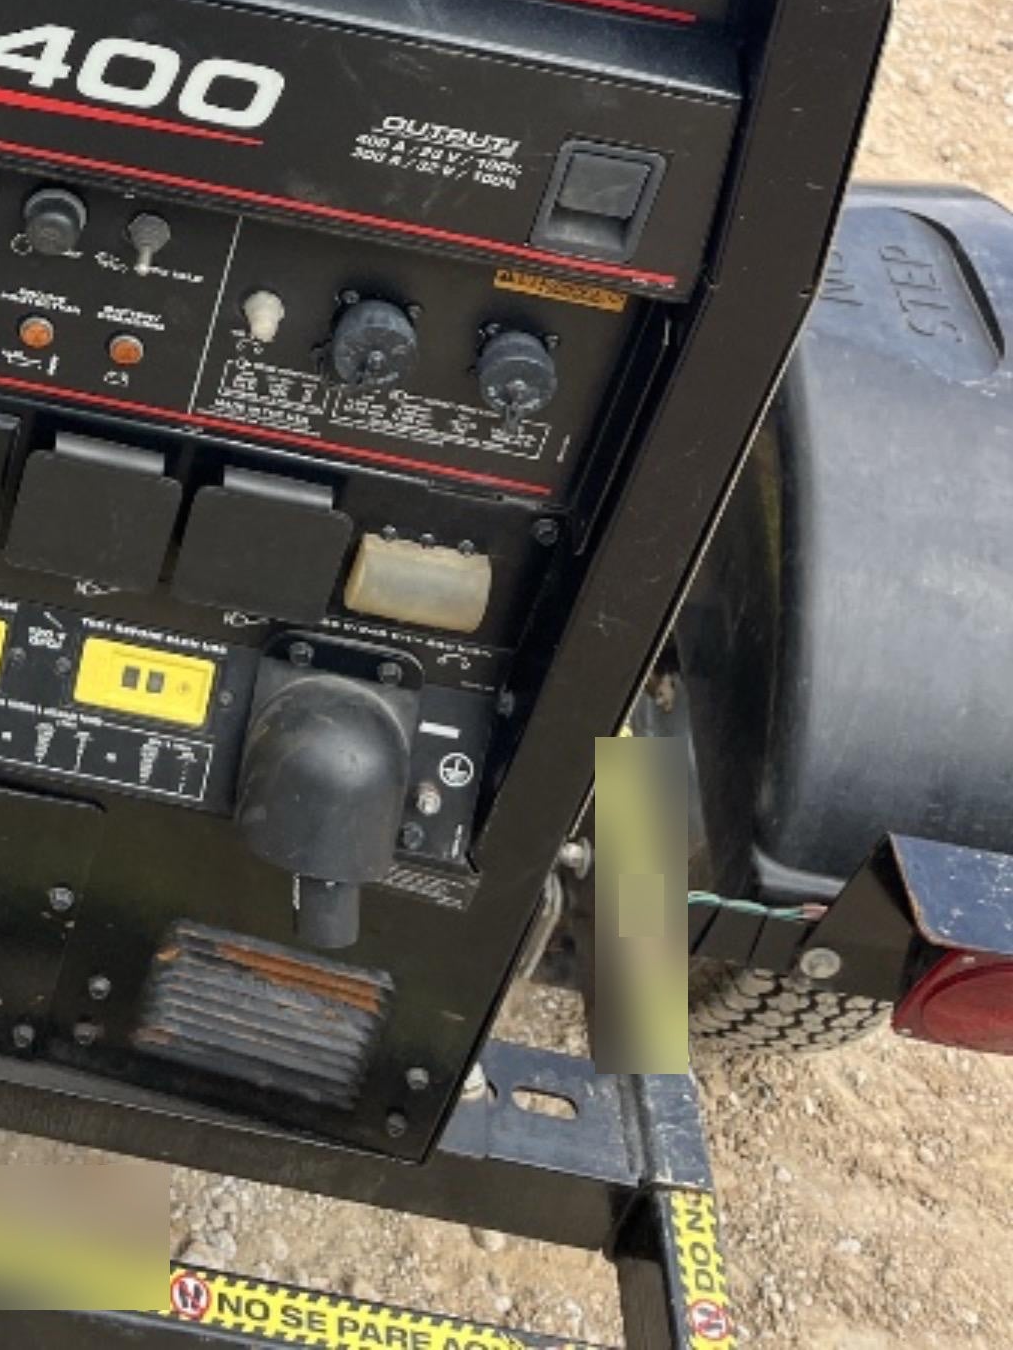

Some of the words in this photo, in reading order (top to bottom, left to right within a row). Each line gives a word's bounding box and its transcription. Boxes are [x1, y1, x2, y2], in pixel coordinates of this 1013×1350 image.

[690, 1241, 716, 1292] DO
[217, 1292, 271, 1322] NO
[280, 1304, 327, 1334] SE
[338, 1317, 432, 1350] PARE
